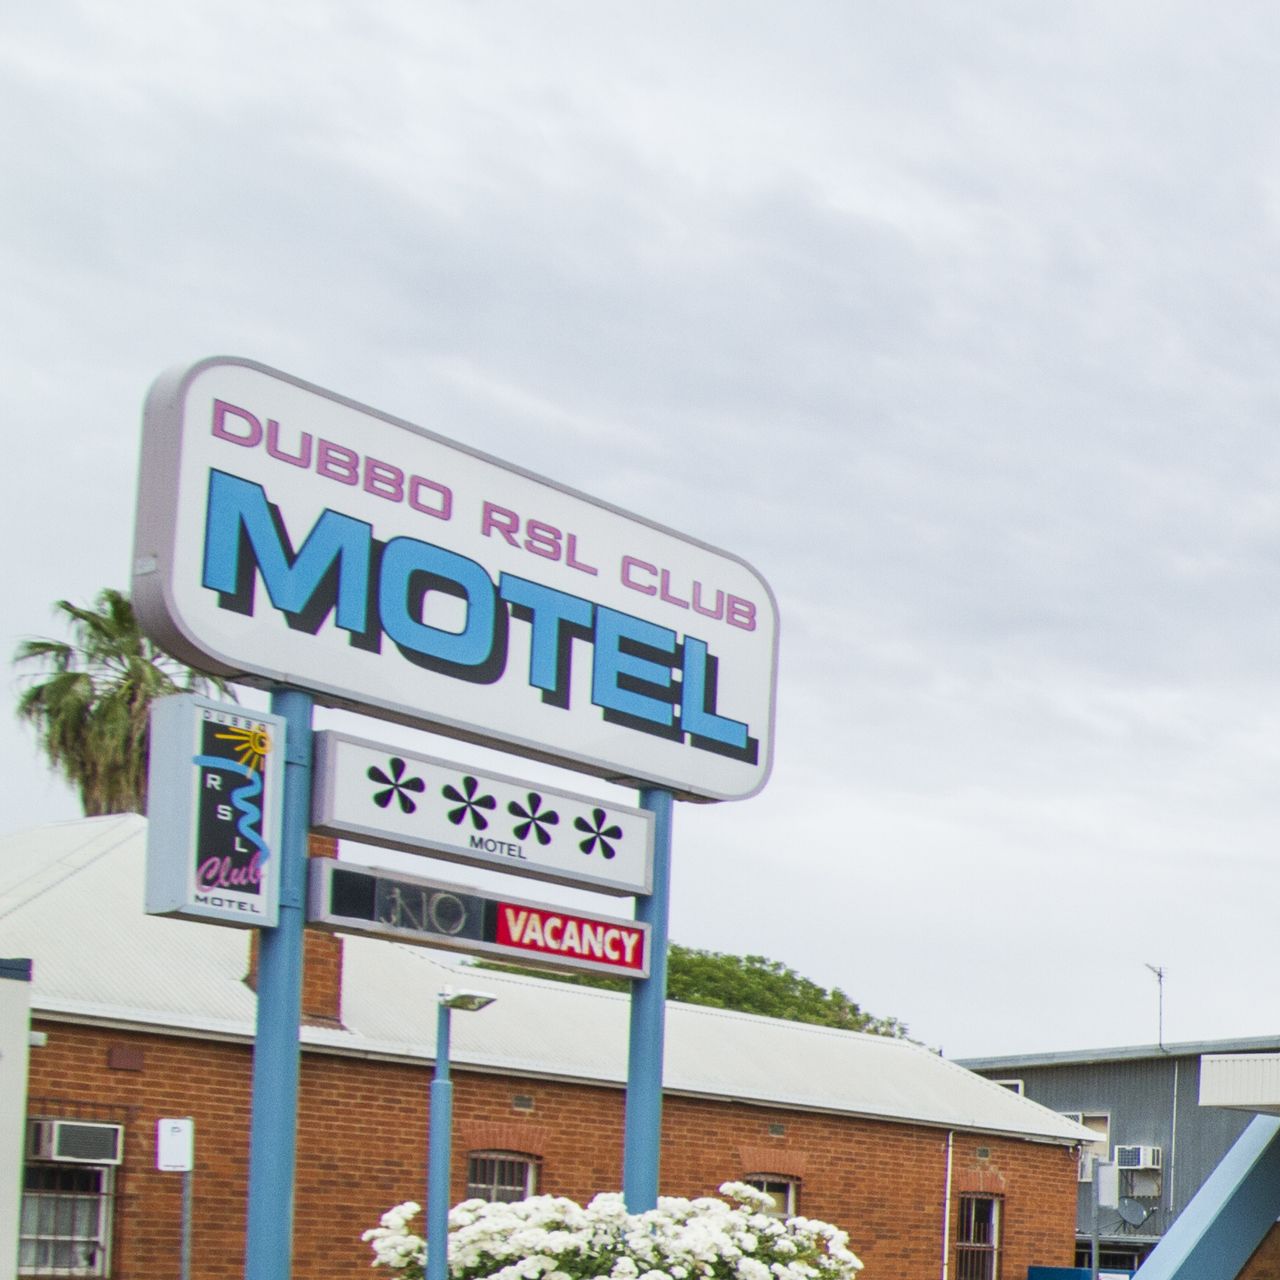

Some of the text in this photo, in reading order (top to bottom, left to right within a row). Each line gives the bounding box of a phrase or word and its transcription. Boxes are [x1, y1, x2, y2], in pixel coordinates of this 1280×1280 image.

[210, 397, 758, 632] DUBBO RSL CLUB
[201, 466, 760, 767] MOTEL
[203, 709, 266, 733] DUBBO
[469, 835, 527, 860] MOTEL
[196, 851, 263, 892] Club
[194, 894, 261, 914] MOTEL
[505, 907, 640, 963] VACANCY
